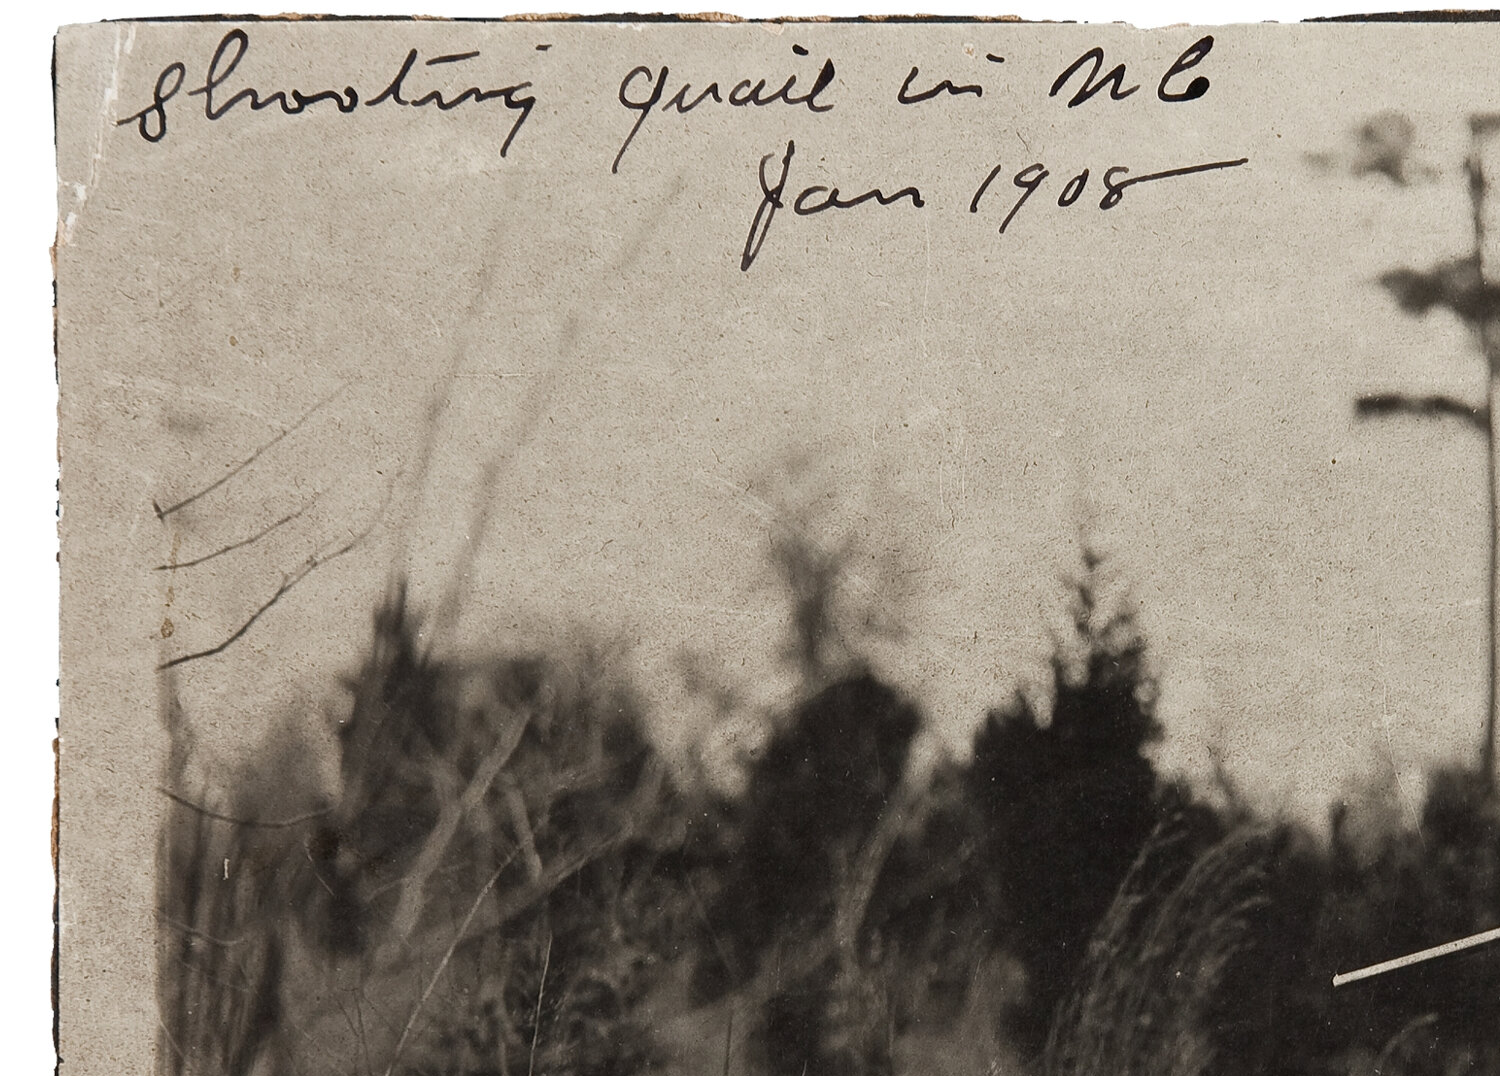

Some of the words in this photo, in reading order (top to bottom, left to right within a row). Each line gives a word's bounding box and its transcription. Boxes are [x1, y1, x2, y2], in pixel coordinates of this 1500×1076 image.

[612, 44, 836, 175] quail
[897, 52, 1003, 105] in
[740, 139, 925, 272] Jan
[969, 158, 1249, 234] 1908
